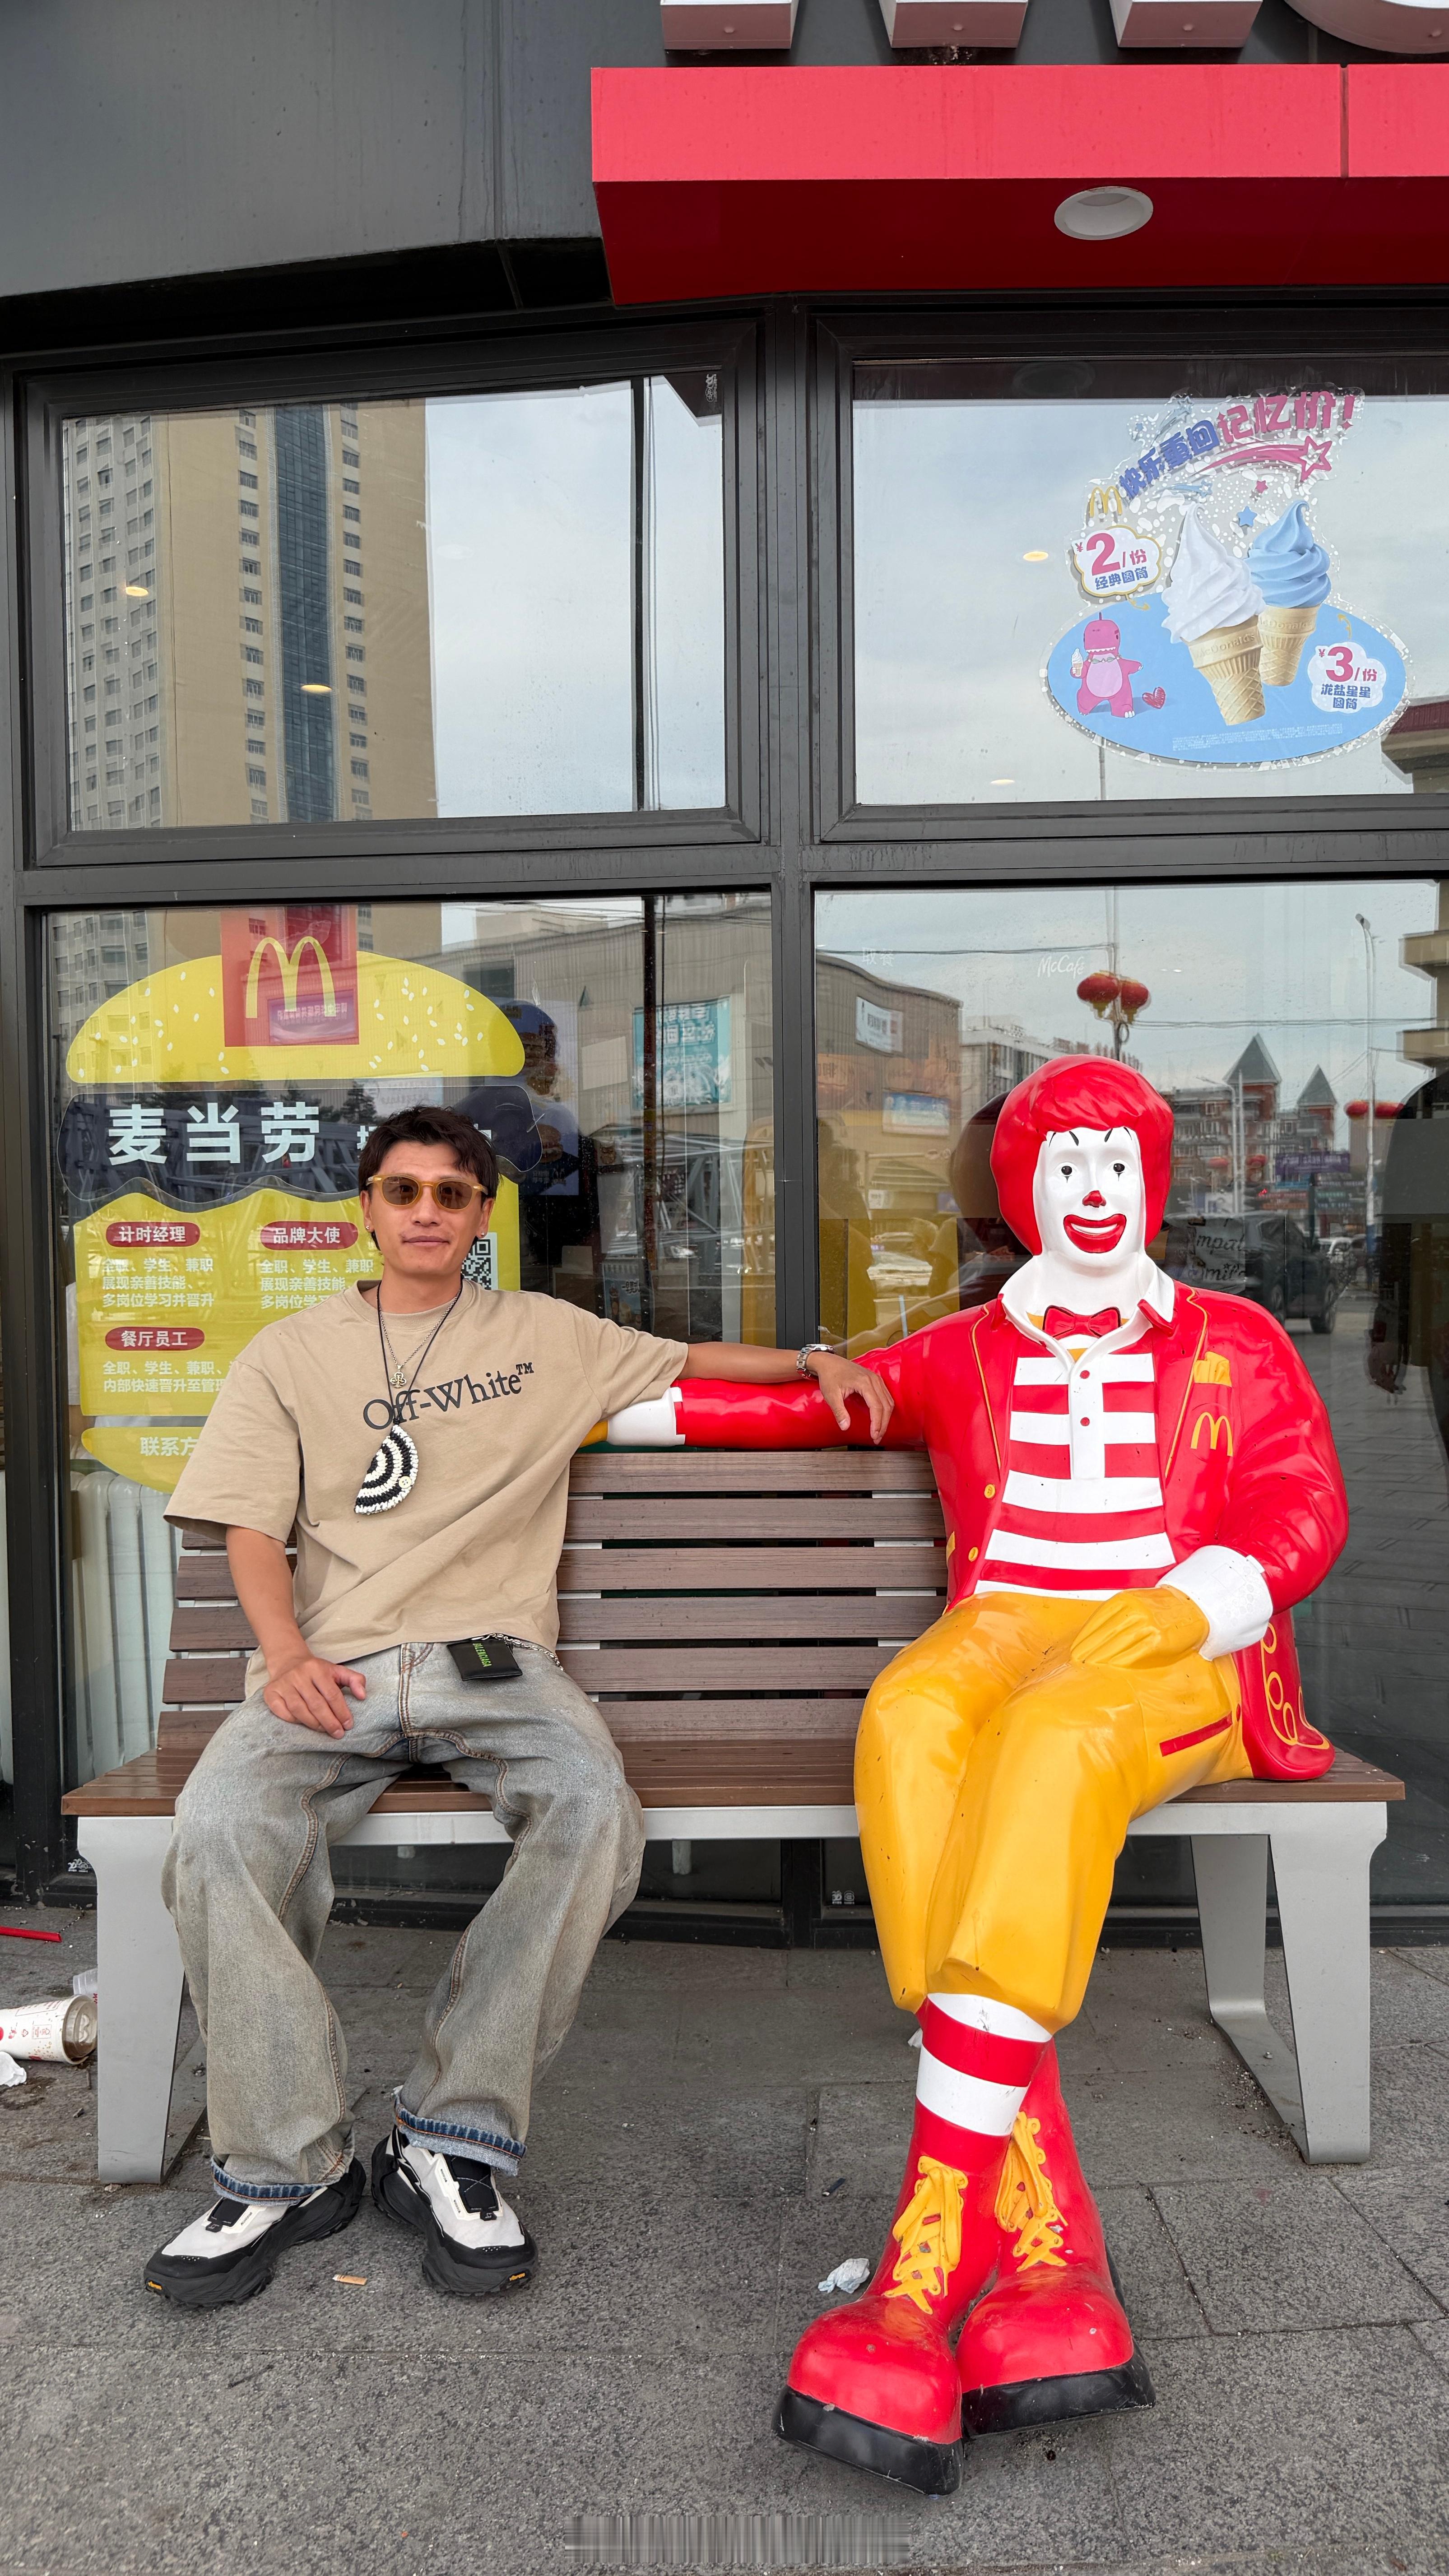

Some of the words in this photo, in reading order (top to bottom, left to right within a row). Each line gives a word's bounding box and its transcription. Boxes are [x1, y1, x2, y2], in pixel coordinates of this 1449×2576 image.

[1095, 566, 1148, 590] 经典圆筒
[1333, 697, 1358, 710] 圆筒
[108, 1101, 320, 1165] 麦当劳
[119, 1225, 186, 1244] 计时经理
[273, 1226, 341, 1244] 品牌大使
[102, 1275, 193, 1290] 展现亲善技能、
[102, 1293, 214, 1308] 多岗位学习并晋升
[121, 1330, 188, 1347] 餐厅员工
[103, 1361, 233, 1375] 全职、学生、兼职、
